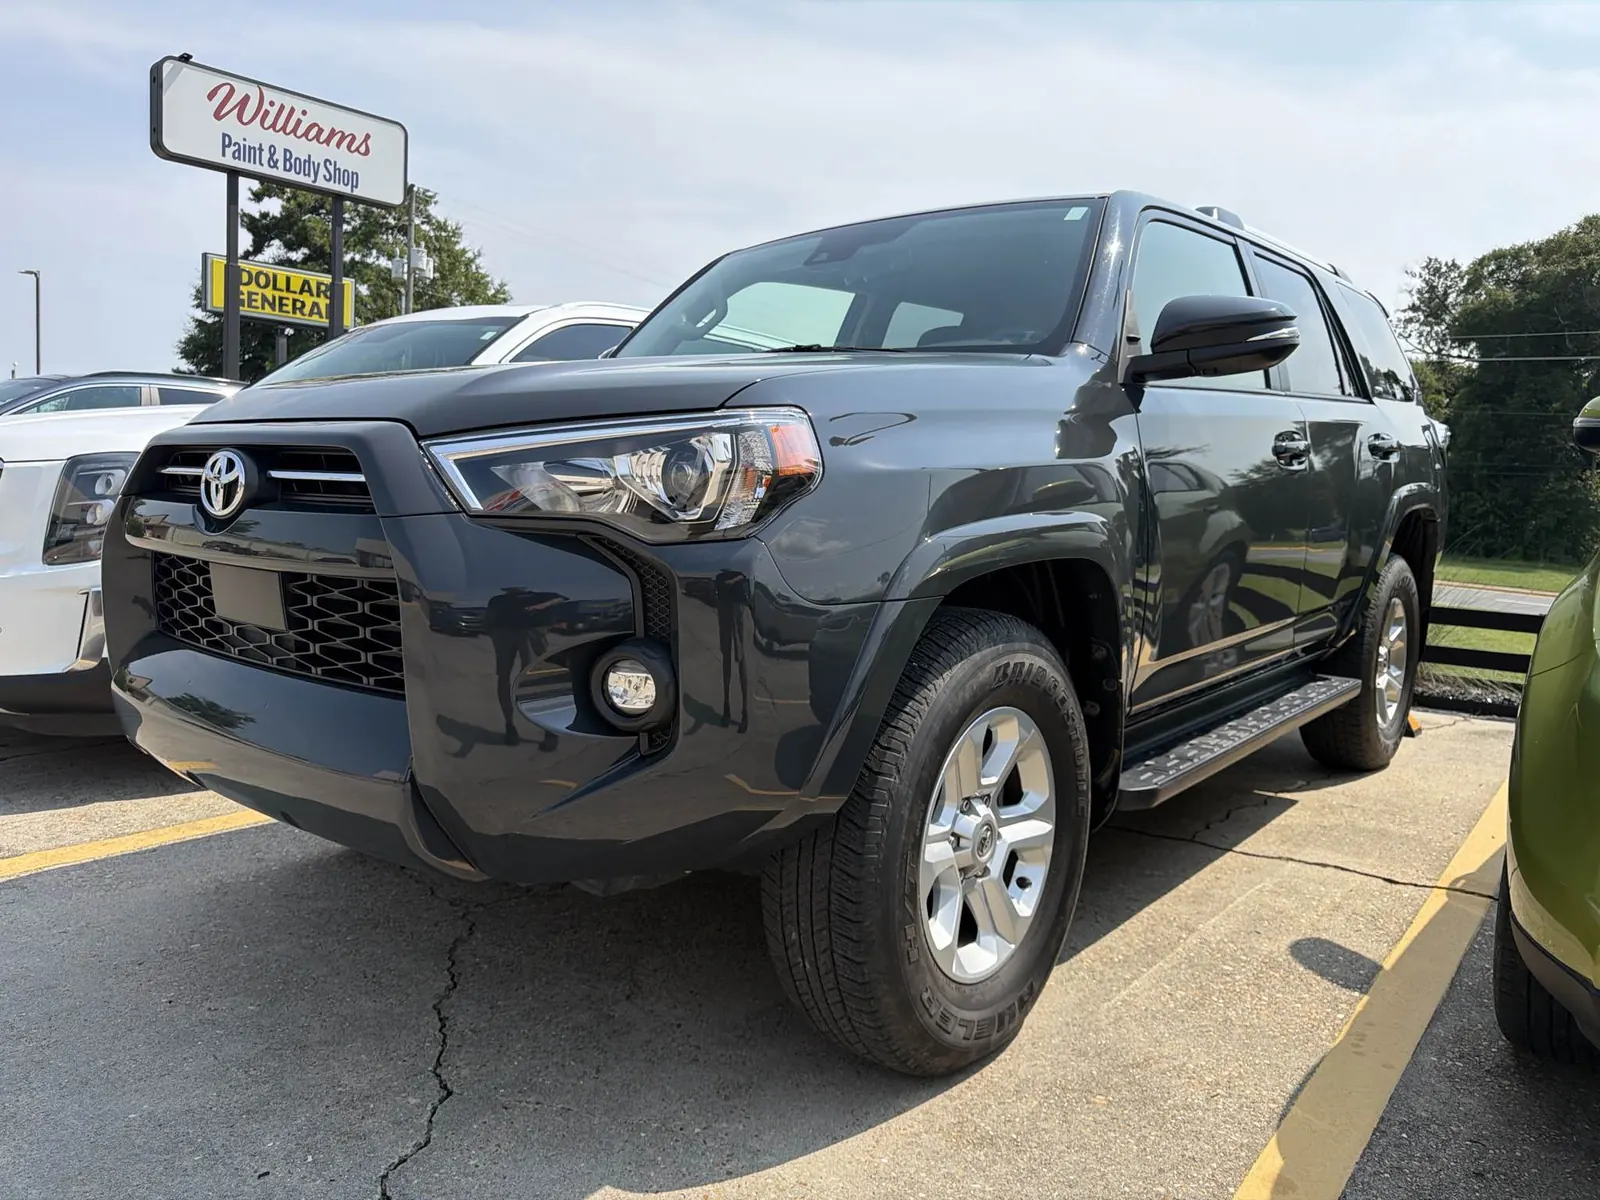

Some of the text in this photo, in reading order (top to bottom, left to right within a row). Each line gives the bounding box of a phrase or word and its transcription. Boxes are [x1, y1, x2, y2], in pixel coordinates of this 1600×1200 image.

[206, 82, 371, 156] Williams
[221, 132, 359, 193] Paint & Body Shop
